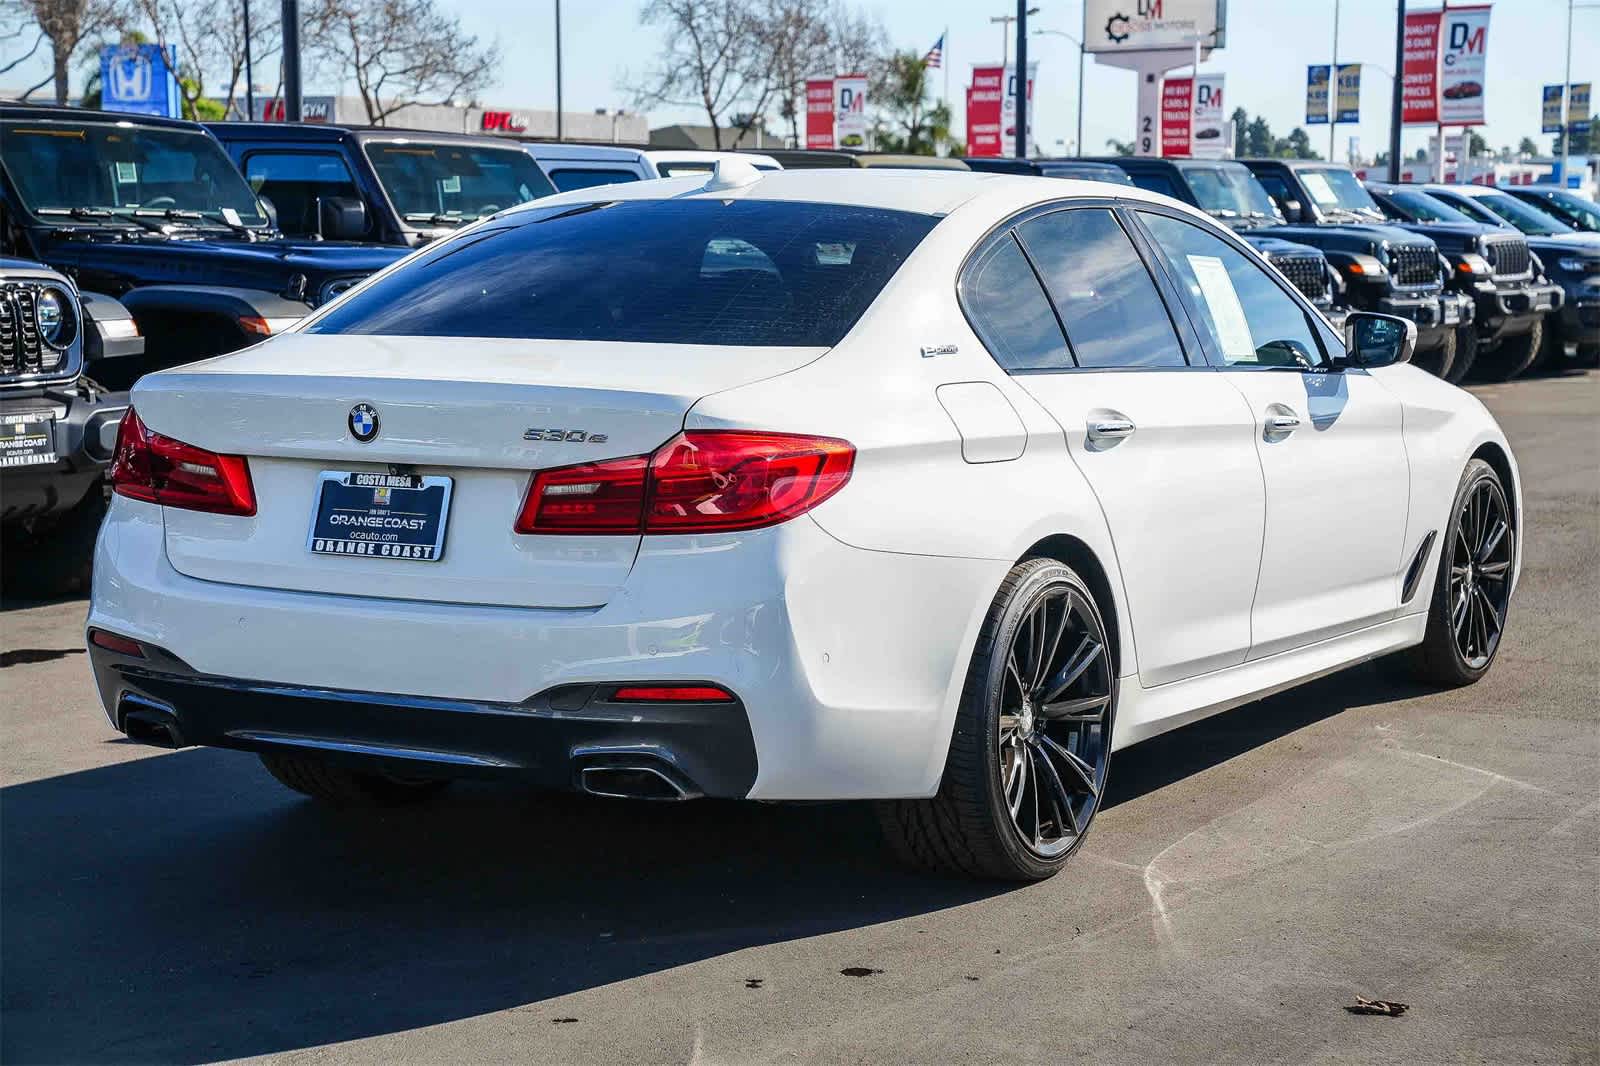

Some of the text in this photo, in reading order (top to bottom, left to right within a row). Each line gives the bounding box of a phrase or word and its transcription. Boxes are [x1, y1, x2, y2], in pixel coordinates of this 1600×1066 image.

[523, 428, 608, 443] 530e
[356, 475, 412, 488] COSTA MESA
[349, 531, 399, 541] ocauto.com
[315, 540, 432, 558] ORANGE COAST
